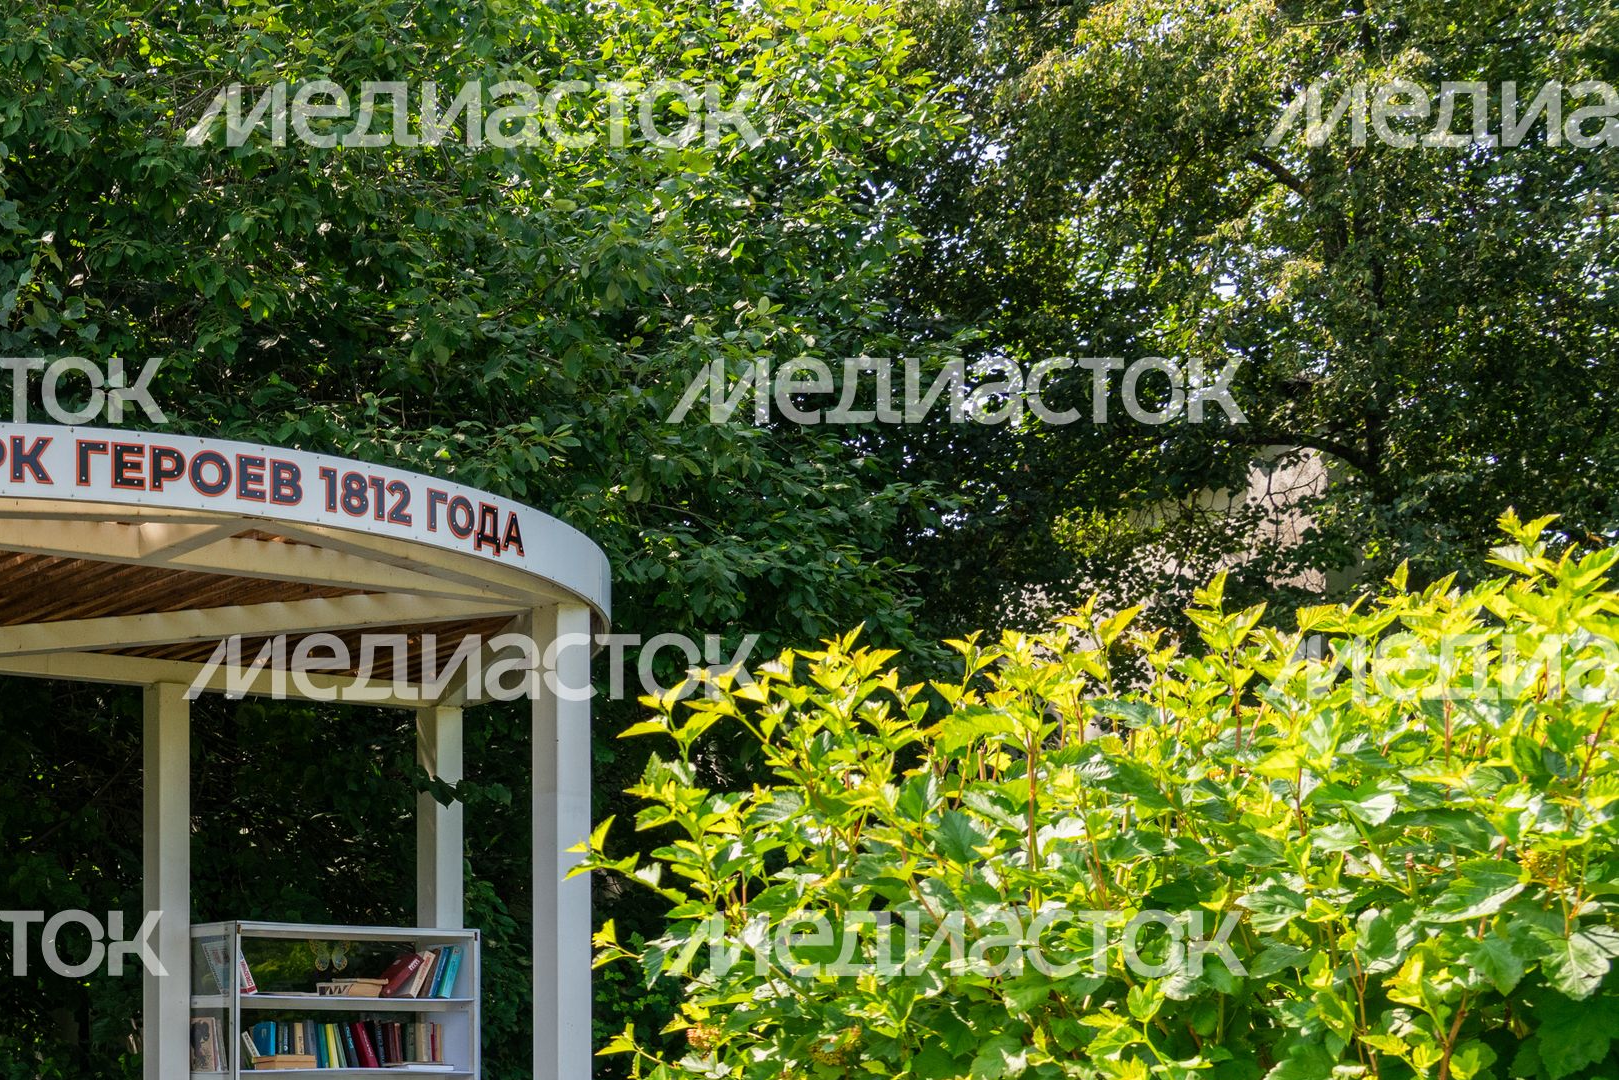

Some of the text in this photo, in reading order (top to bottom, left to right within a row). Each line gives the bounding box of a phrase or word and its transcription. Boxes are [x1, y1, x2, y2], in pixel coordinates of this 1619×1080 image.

[76, 438, 303, 506] ГЕРОЕВ
[319, 466, 413, 526] 1812
[426, 488, 525, 558] ГОДА
